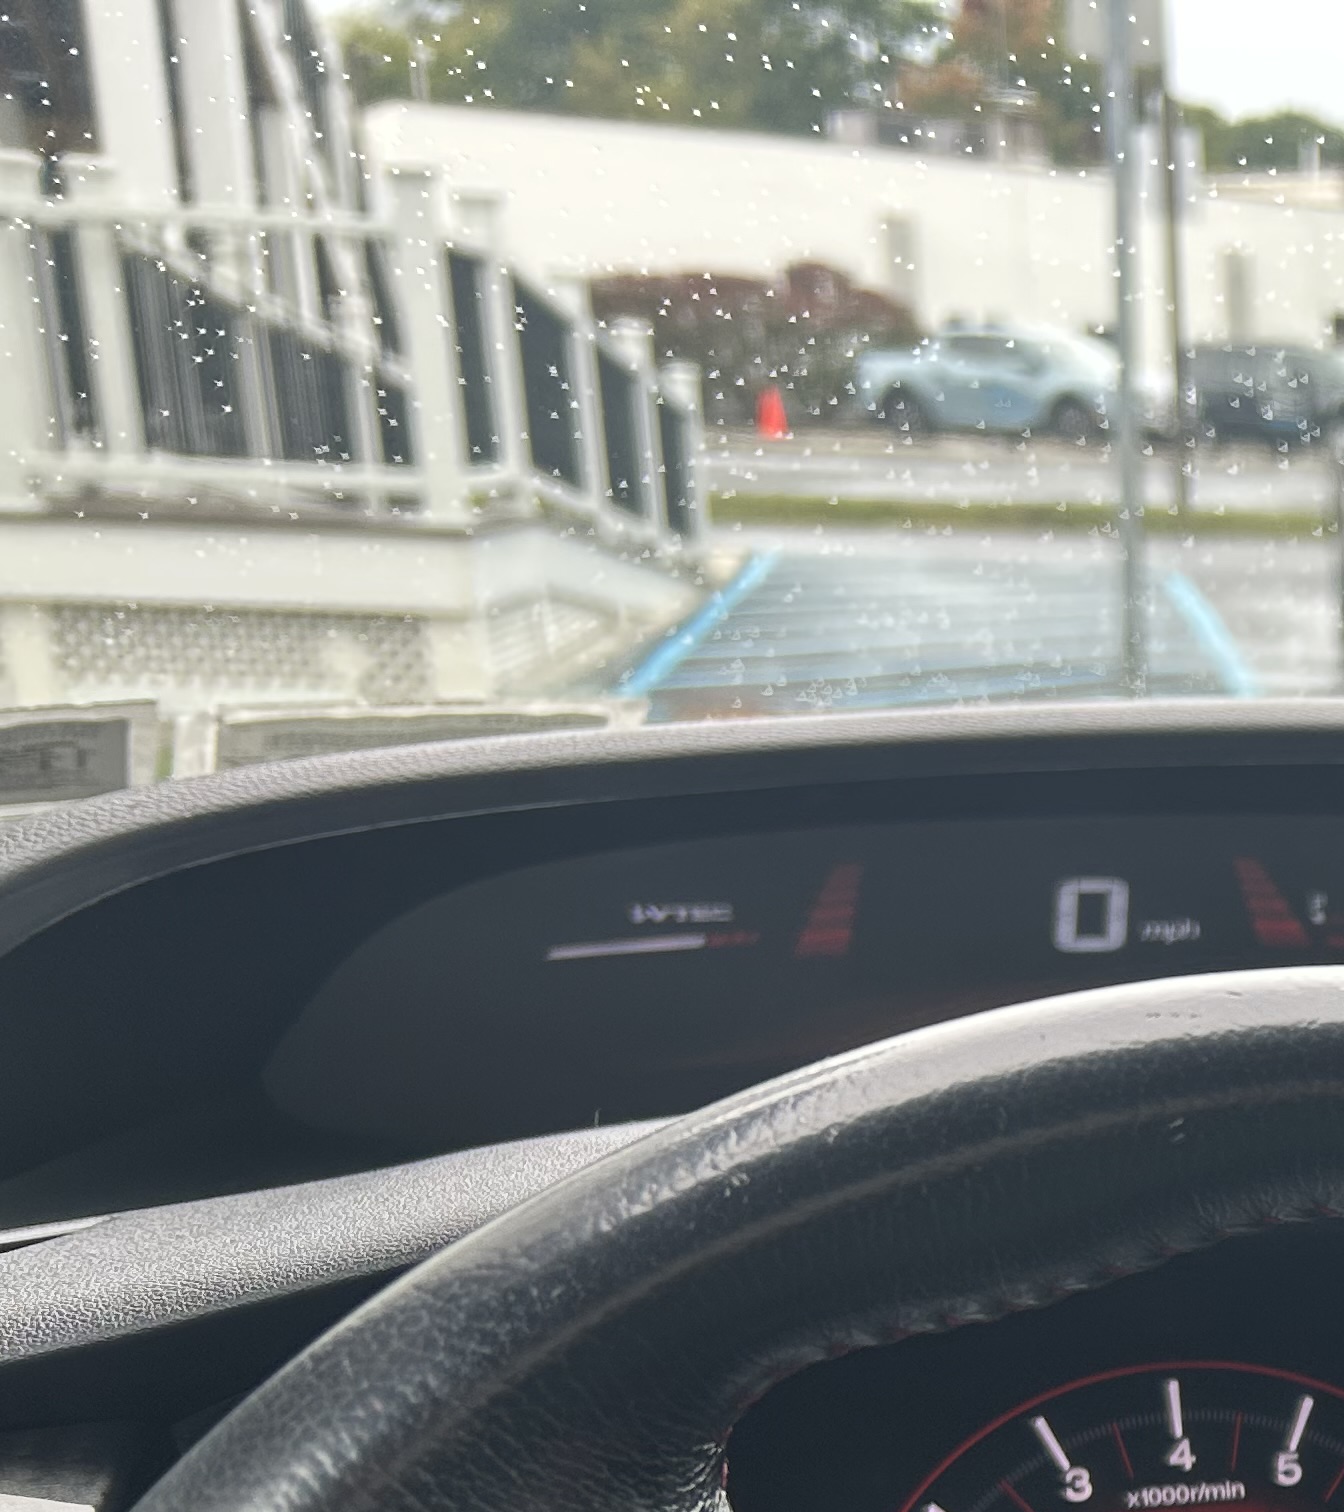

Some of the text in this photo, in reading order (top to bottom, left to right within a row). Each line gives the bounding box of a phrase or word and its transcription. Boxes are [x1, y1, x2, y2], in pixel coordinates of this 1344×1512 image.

[1052, 876, 1130, 953] 0
[1168, 1440, 1196, 1472] 4
[1275, 1454, 1302, 1488] 5
[1064, 1467, 1094, 1503] 3
[1126, 1479, 1246, 1509] x1000r/min
